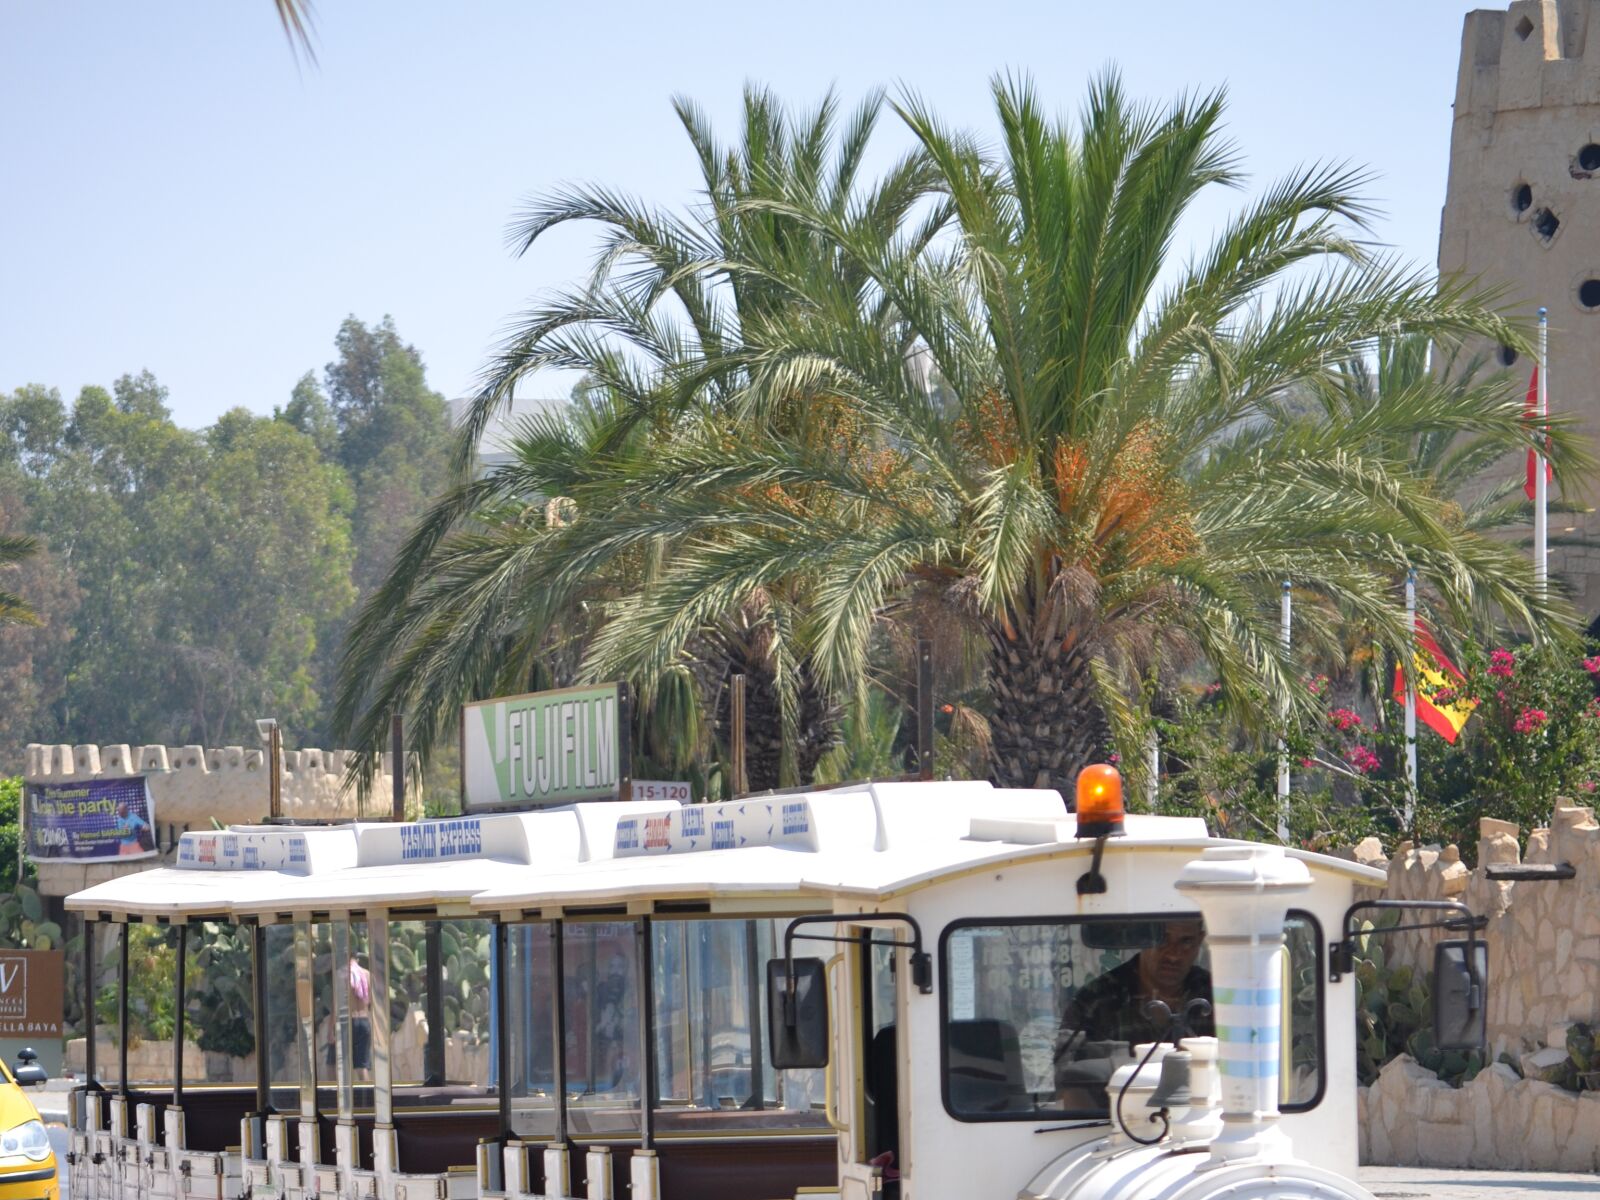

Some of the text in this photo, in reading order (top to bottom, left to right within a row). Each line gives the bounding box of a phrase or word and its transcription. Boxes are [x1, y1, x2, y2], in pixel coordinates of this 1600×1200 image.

[509, 696, 615, 798] FUJIFILM
[57, 799, 75, 815] the
[79, 797, 117, 818] party
[439, 820, 482, 857] EXPRESS
[27, 1022, 58, 1032] BAYA
